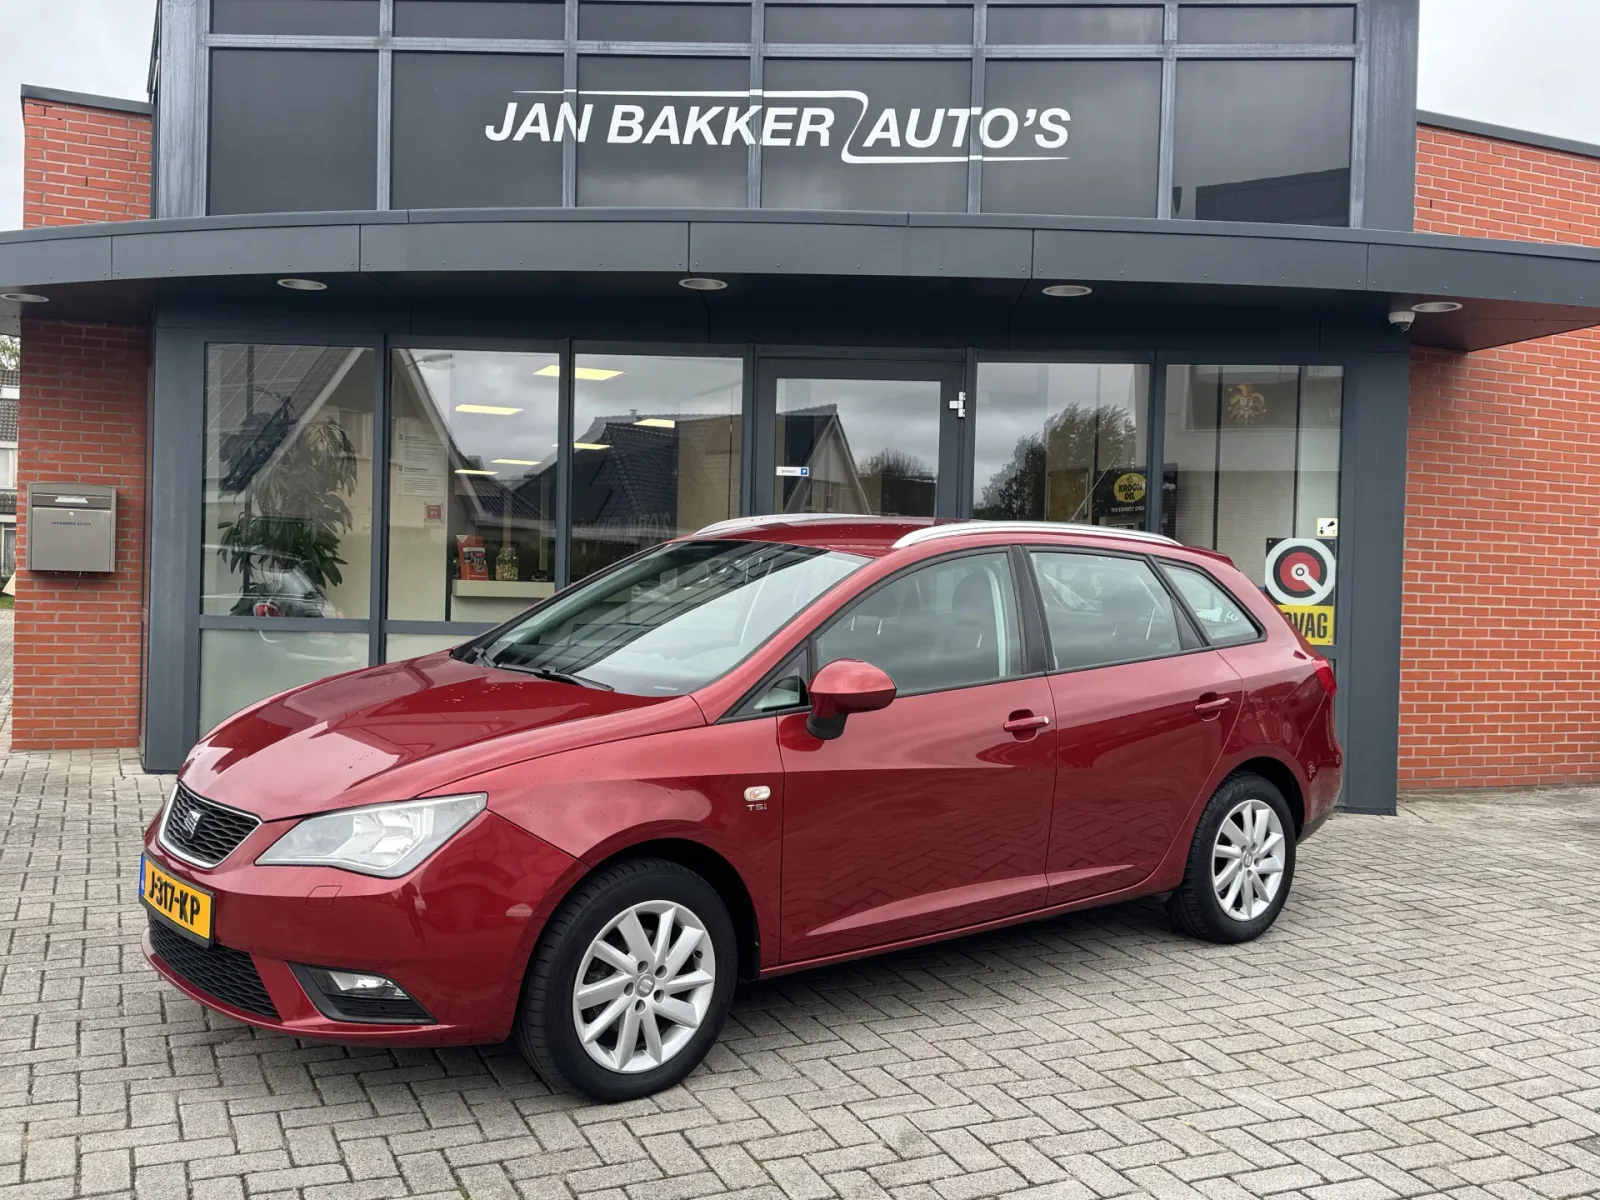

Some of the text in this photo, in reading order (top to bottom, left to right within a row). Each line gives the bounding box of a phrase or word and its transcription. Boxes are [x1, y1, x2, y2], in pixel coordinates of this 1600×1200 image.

[485, 102, 1071, 149] JAN BAKKER AUTO'S
[1119, 484, 1142, 492] KROON
[1125, 492, 1135, 500] OIL
[149, 871, 200, 925] J-317-KP
